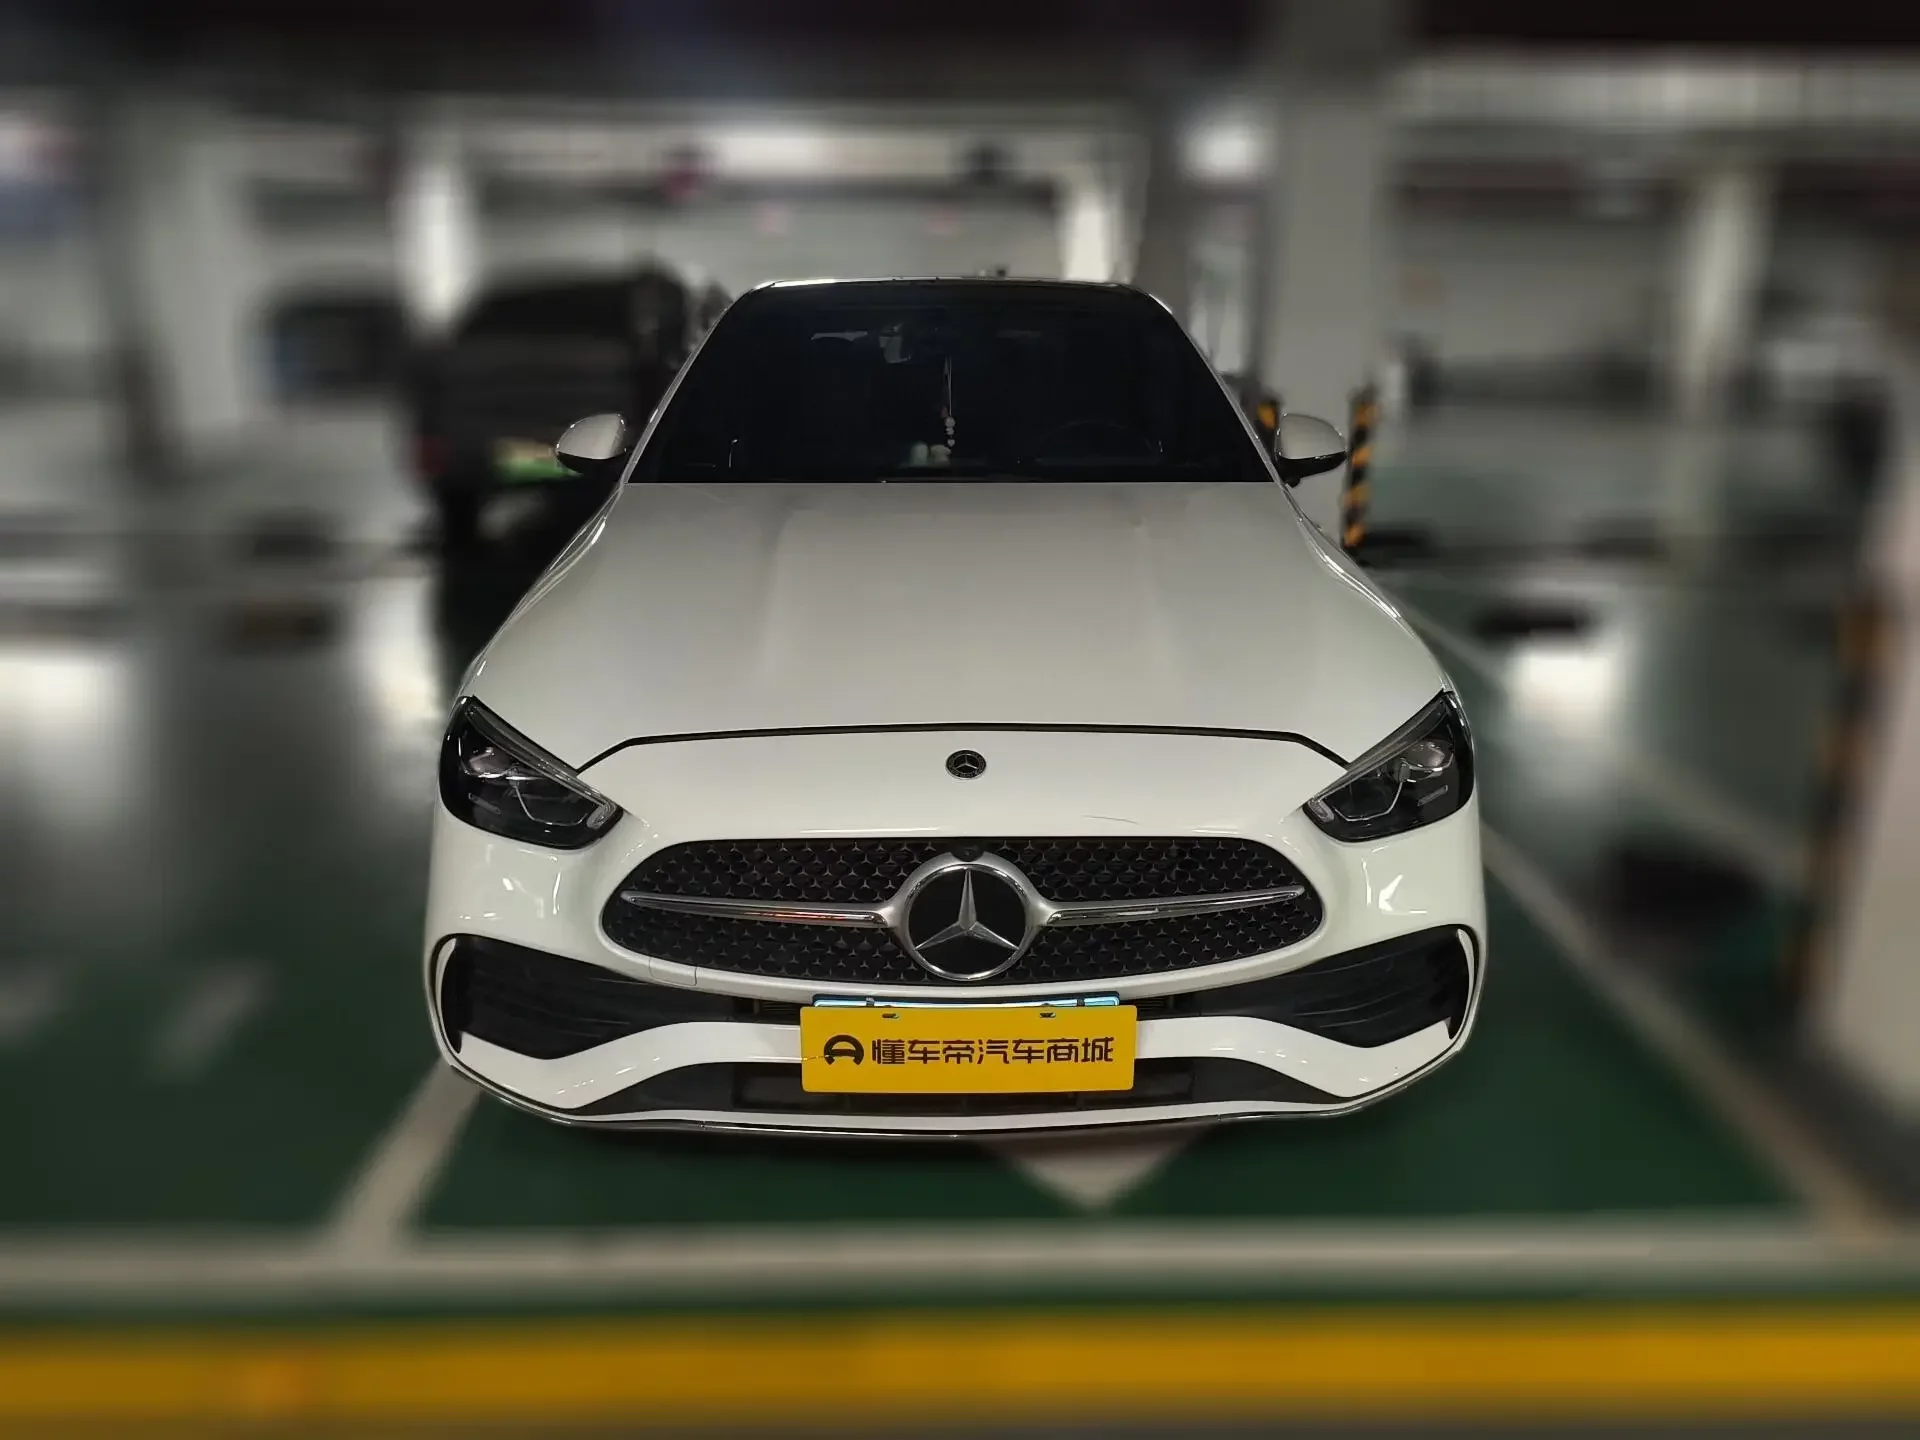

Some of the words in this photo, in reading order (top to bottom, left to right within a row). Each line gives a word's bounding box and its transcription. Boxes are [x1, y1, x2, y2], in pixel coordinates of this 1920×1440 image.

[871, 1036, 1115, 1065] 懂车帝汽车商城
